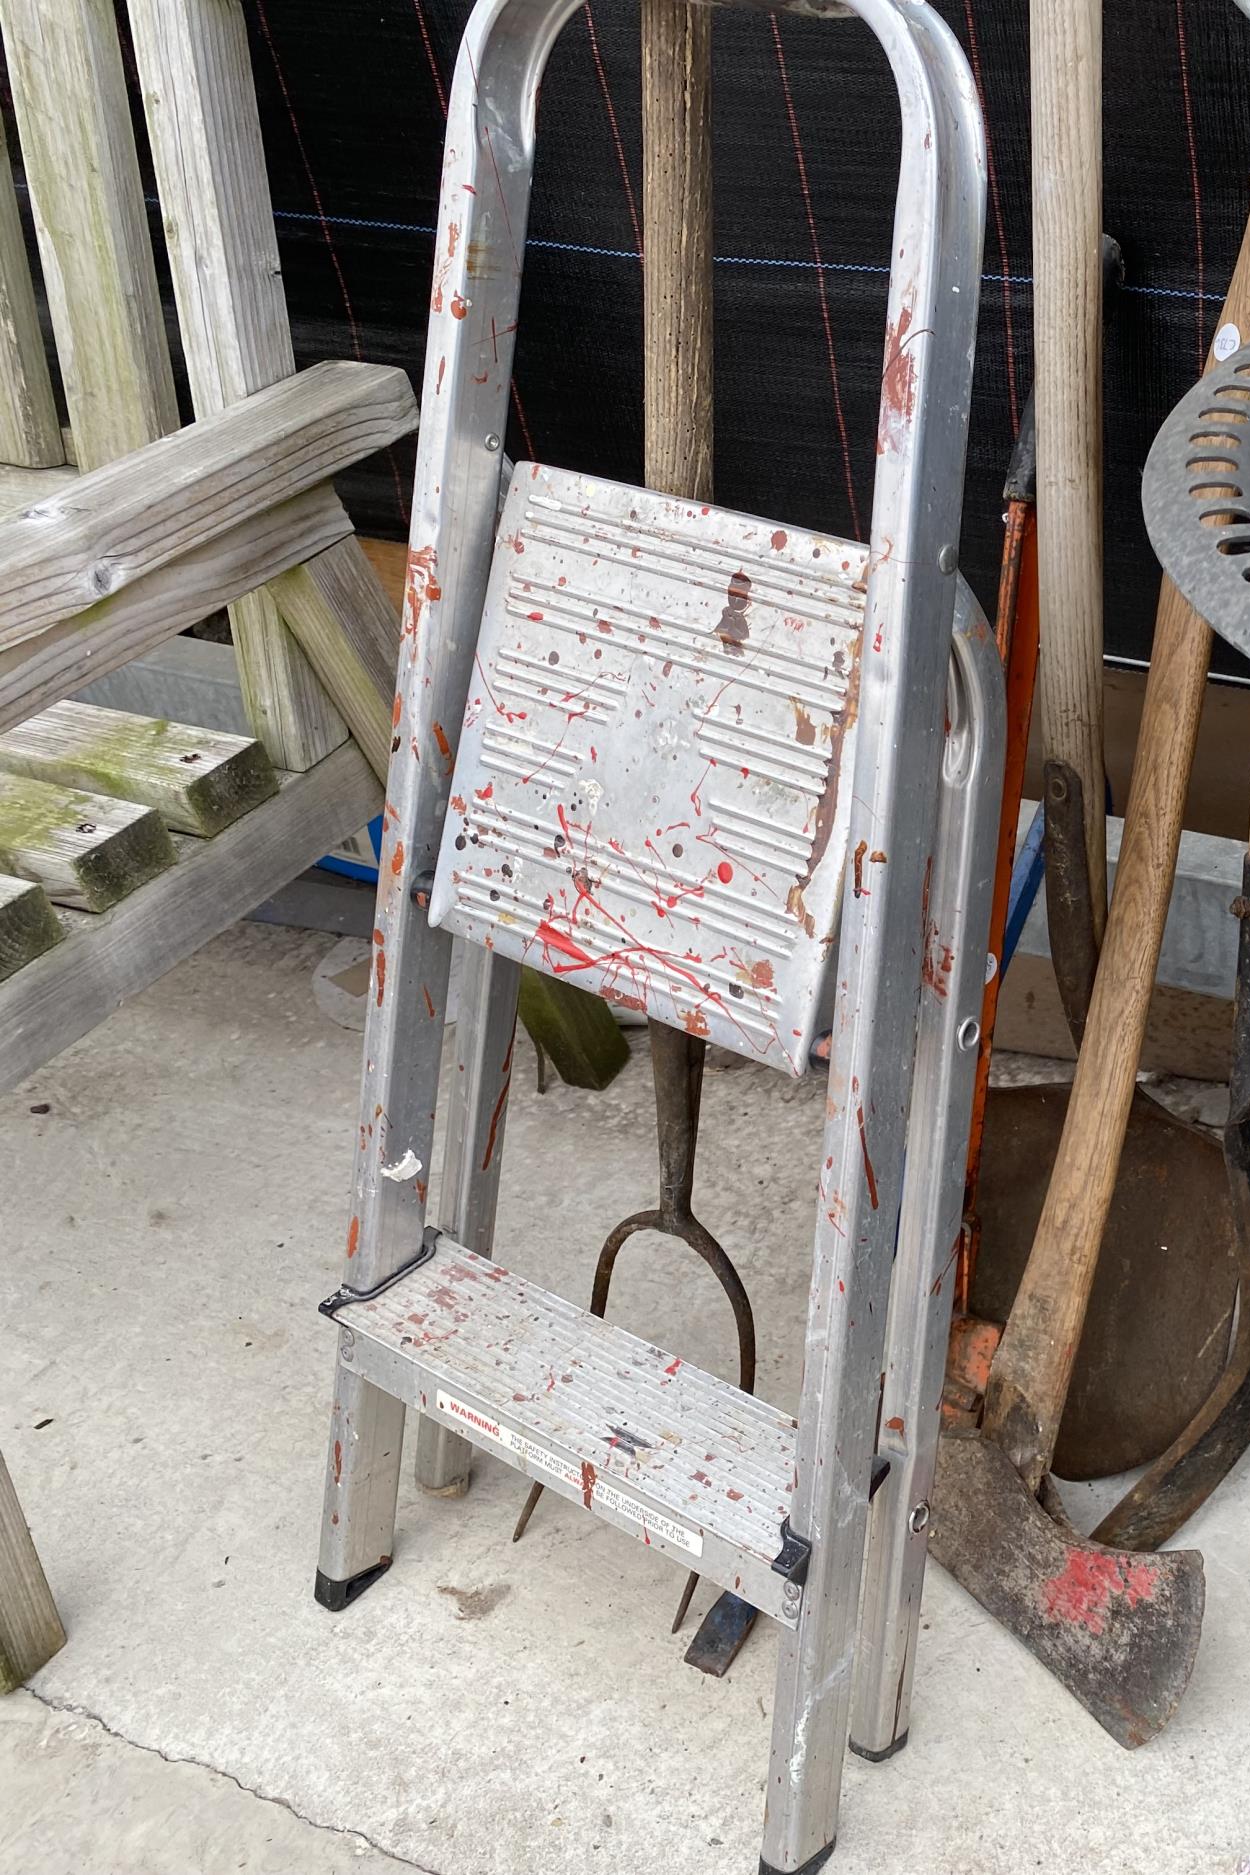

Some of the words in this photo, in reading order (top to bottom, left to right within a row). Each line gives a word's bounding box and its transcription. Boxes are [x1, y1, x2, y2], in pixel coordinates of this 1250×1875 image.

[450, 1401, 500, 1437] WARNING
[510, 1440, 543, 1464] PLATFORM
[544, 1460, 564, 1474] MUST
[564, 1472, 583, 1486] ALW
[596, 1490, 605, 1499] BE
[606, 1493, 642, 1520] FOLLOWED
[644, 1516, 664, 1531] PRIOR
[665, 1528, 675, 1539] TO
[677, 1535, 690, 1548] USE
[511, 1434, 523, 1446] THE
[524, 1440, 549, 1459] SAFETY
[549, 1455, 584, 1479] INSTRUCT
[607, 1489, 620, 1502] THE
[622, 1496, 659, 1522] UNDERSIDE
[661, 1518, 670, 1529] OF
[672, 1524, 685, 1537] THE
